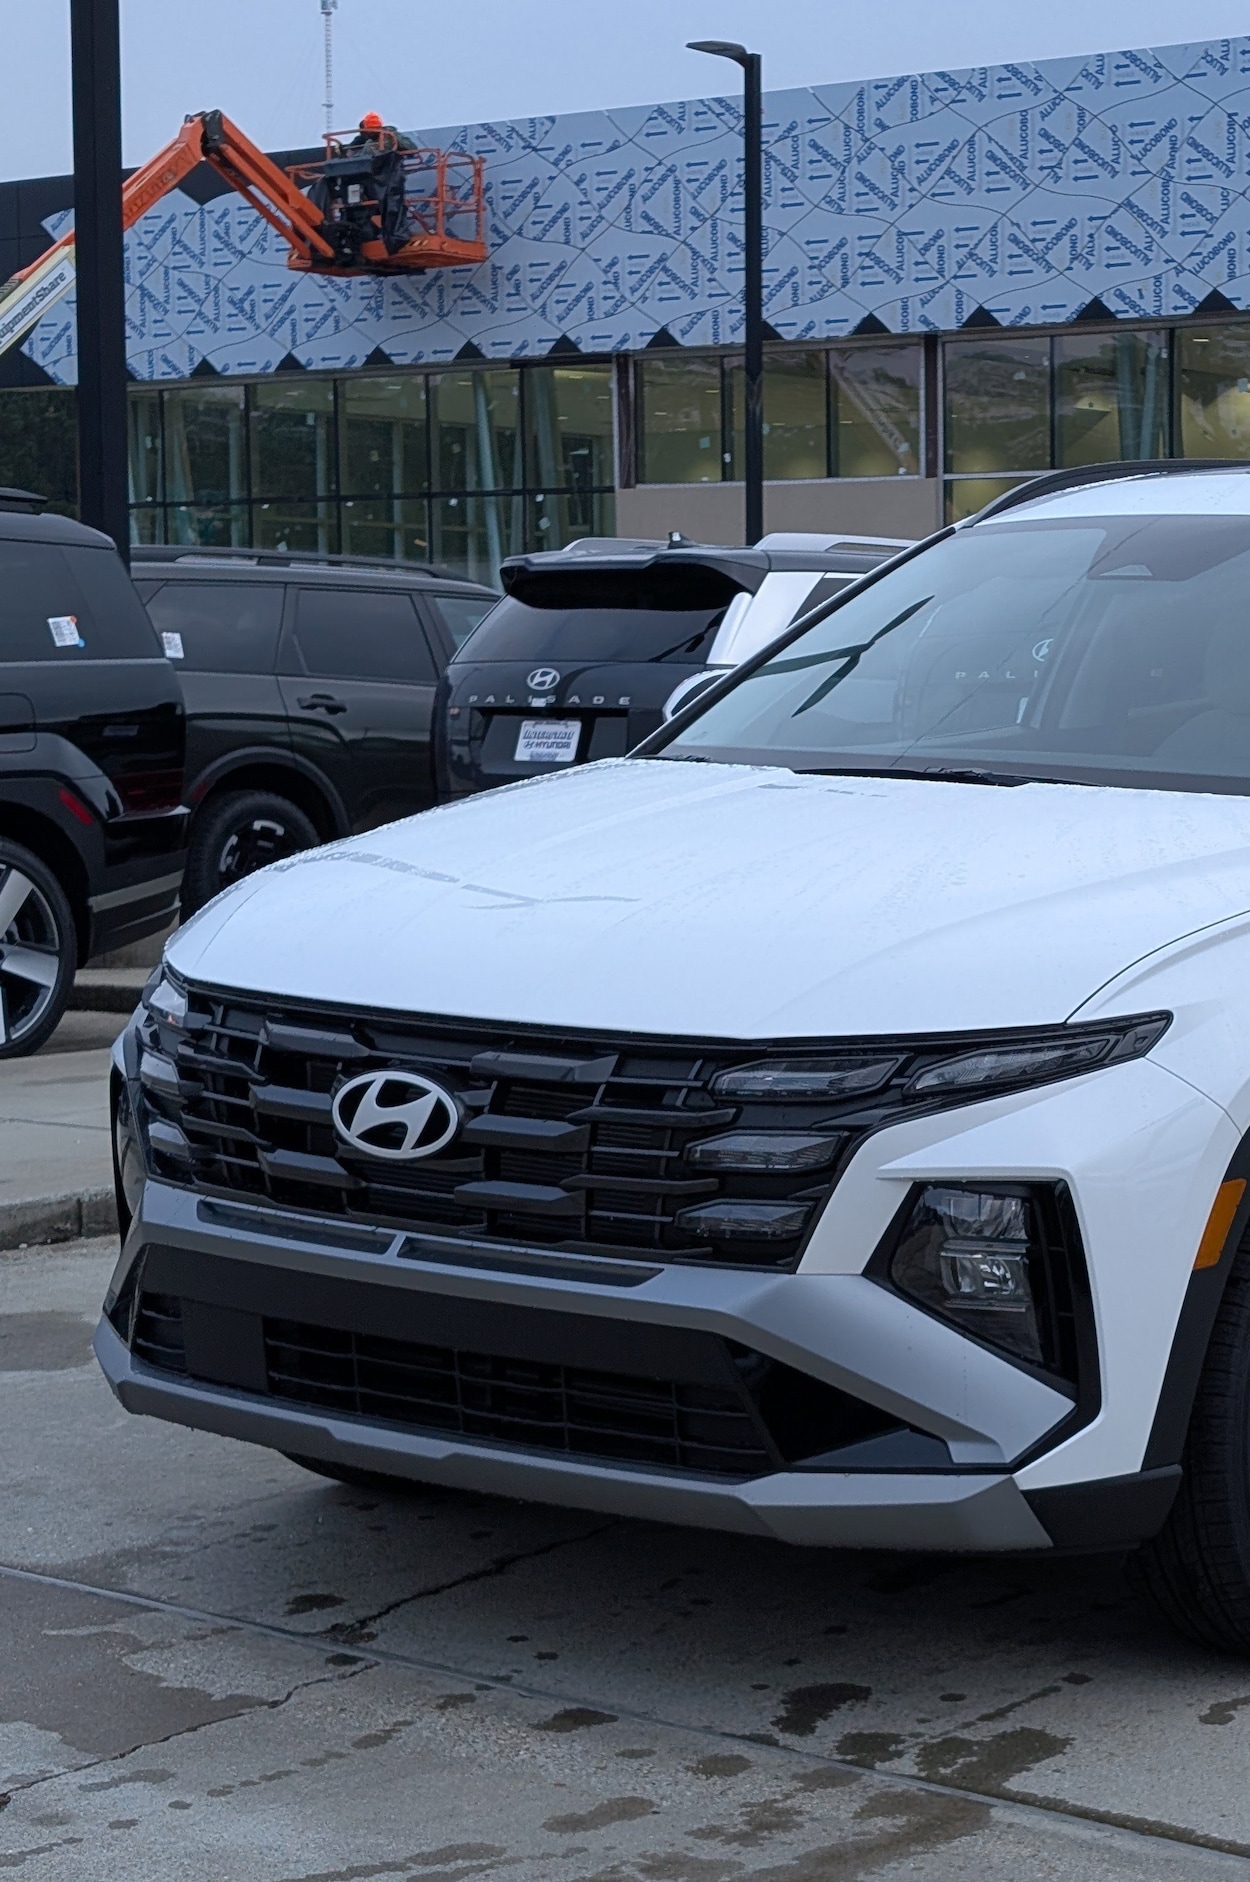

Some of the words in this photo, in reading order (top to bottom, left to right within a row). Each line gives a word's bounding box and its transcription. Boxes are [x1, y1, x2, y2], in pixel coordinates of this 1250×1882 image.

[1072, 137, 1120, 179] ALUCOBOND
[1186, 136, 1235, 178] ALUCOBOND
[1105, 224, 1153, 267] ALUCOBOND
[468, 695, 631, 706] PALISADE
